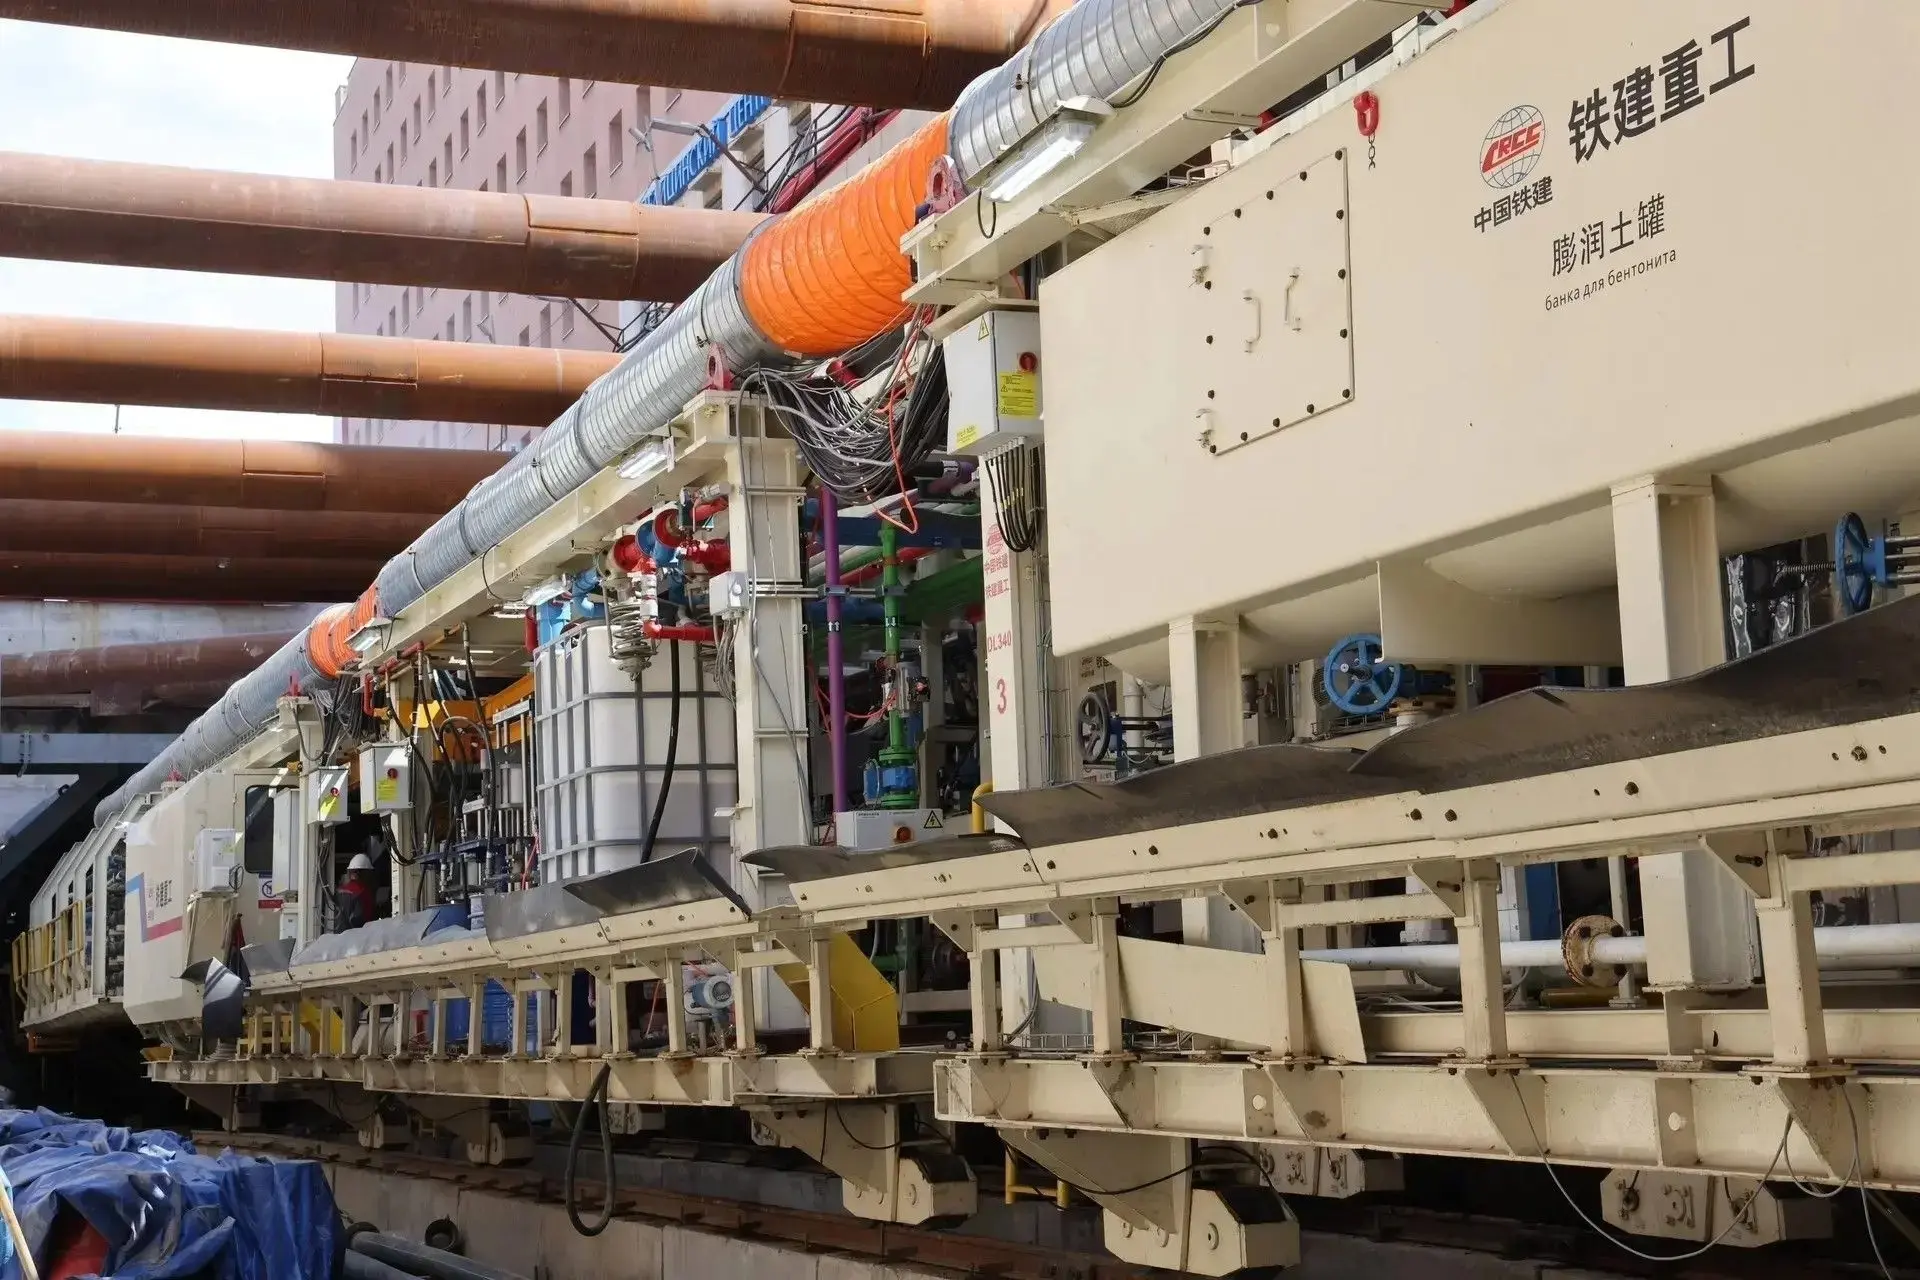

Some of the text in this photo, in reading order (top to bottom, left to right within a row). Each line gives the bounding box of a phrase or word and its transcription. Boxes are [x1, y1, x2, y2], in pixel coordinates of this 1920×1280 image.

[1568, 16, 1755, 164] 铁建重工
[1482, 121, 1542, 173] CRCC
[1473, 176, 1553, 233] 中国铁建
[1552, 193, 1665, 277] 膨润土罐
[1545, 249, 1677, 311] банка для бентонита
[988, 630, 1011, 652] DL340
[996, 679, 1007, 714] 3
